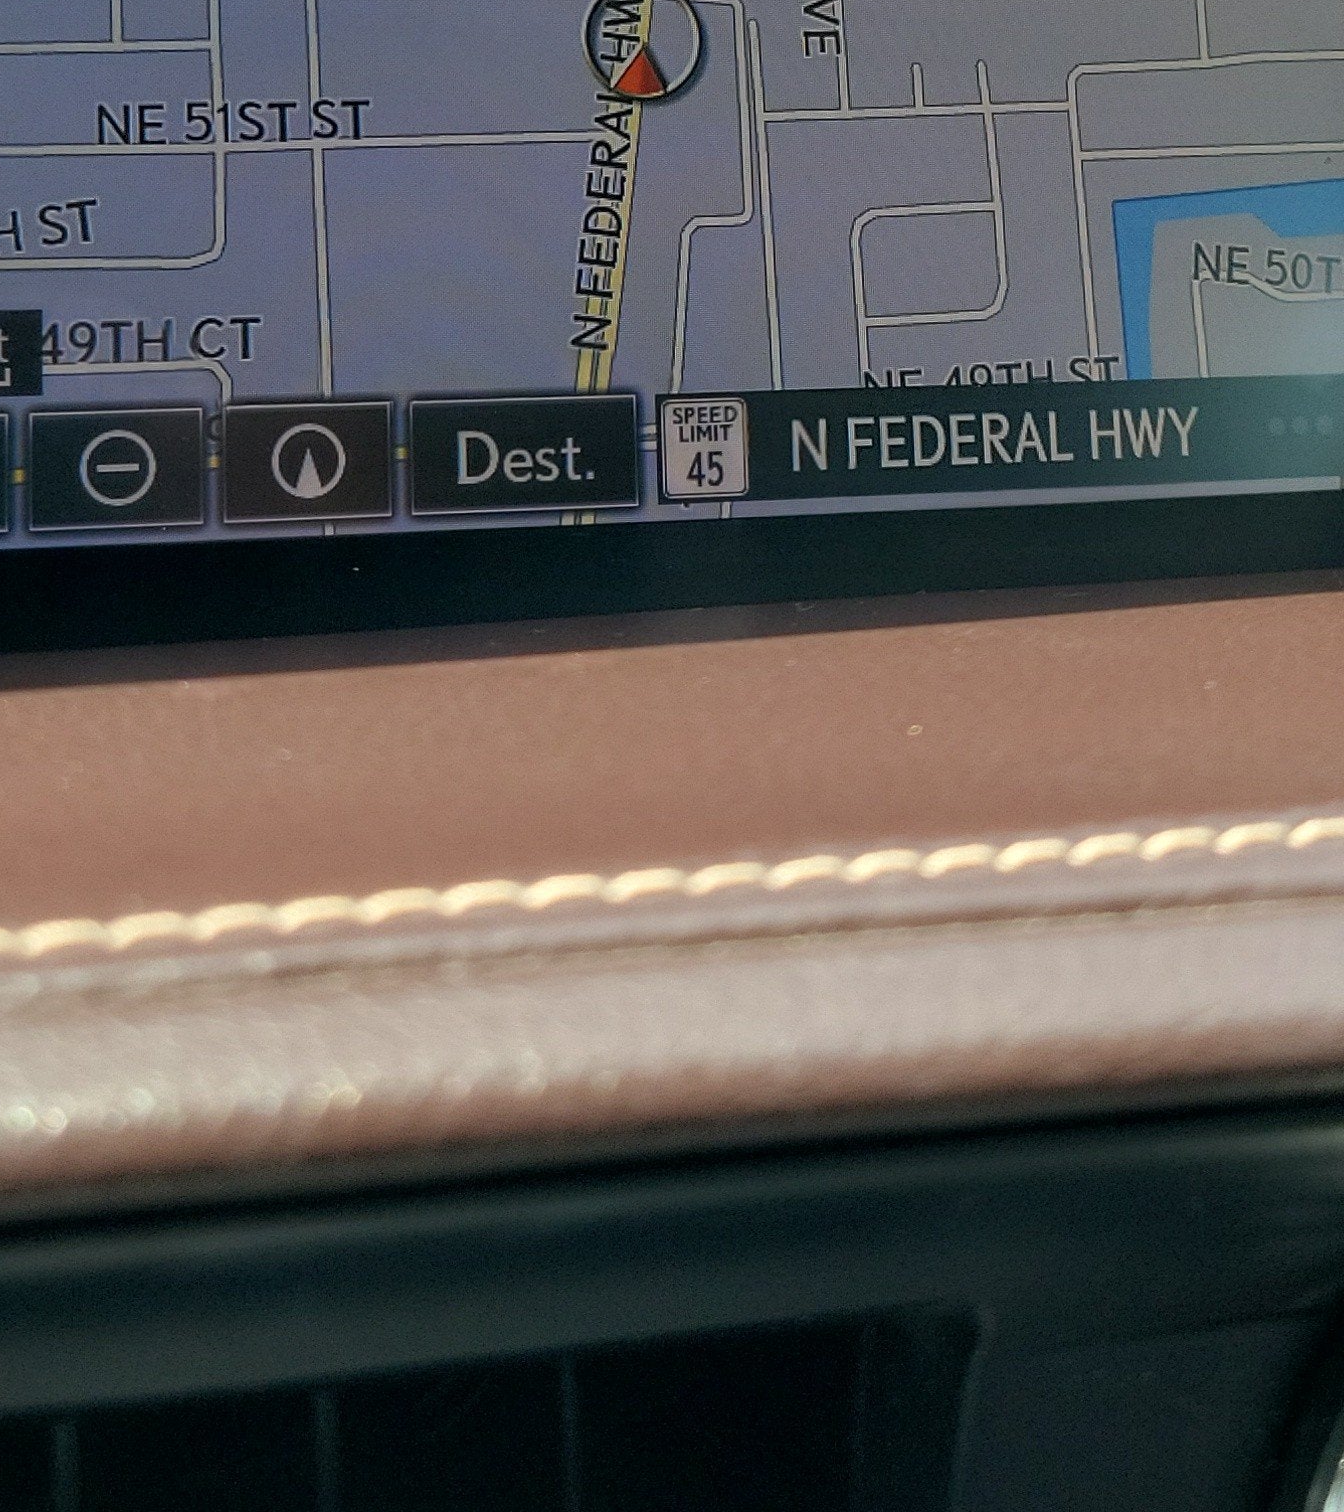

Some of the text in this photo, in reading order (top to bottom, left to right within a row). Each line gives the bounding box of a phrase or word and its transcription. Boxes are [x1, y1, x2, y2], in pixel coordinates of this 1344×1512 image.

[97, 99, 370, 145] NE 51ST ST
[38, 198, 97, 245] ST
[1193, 242, 1249, 284] NE
[42, 316, 262, 365] 49TH CT
[570, 313, 612, 350] N
[673, 406, 738, 424] SPEED
[679, 424, 733, 443] LIMIT
[456, 431, 595, 486] Dest.
[790, 406, 1199, 472] N FEDERAL HWY
[686, 451, 724, 487] 45
